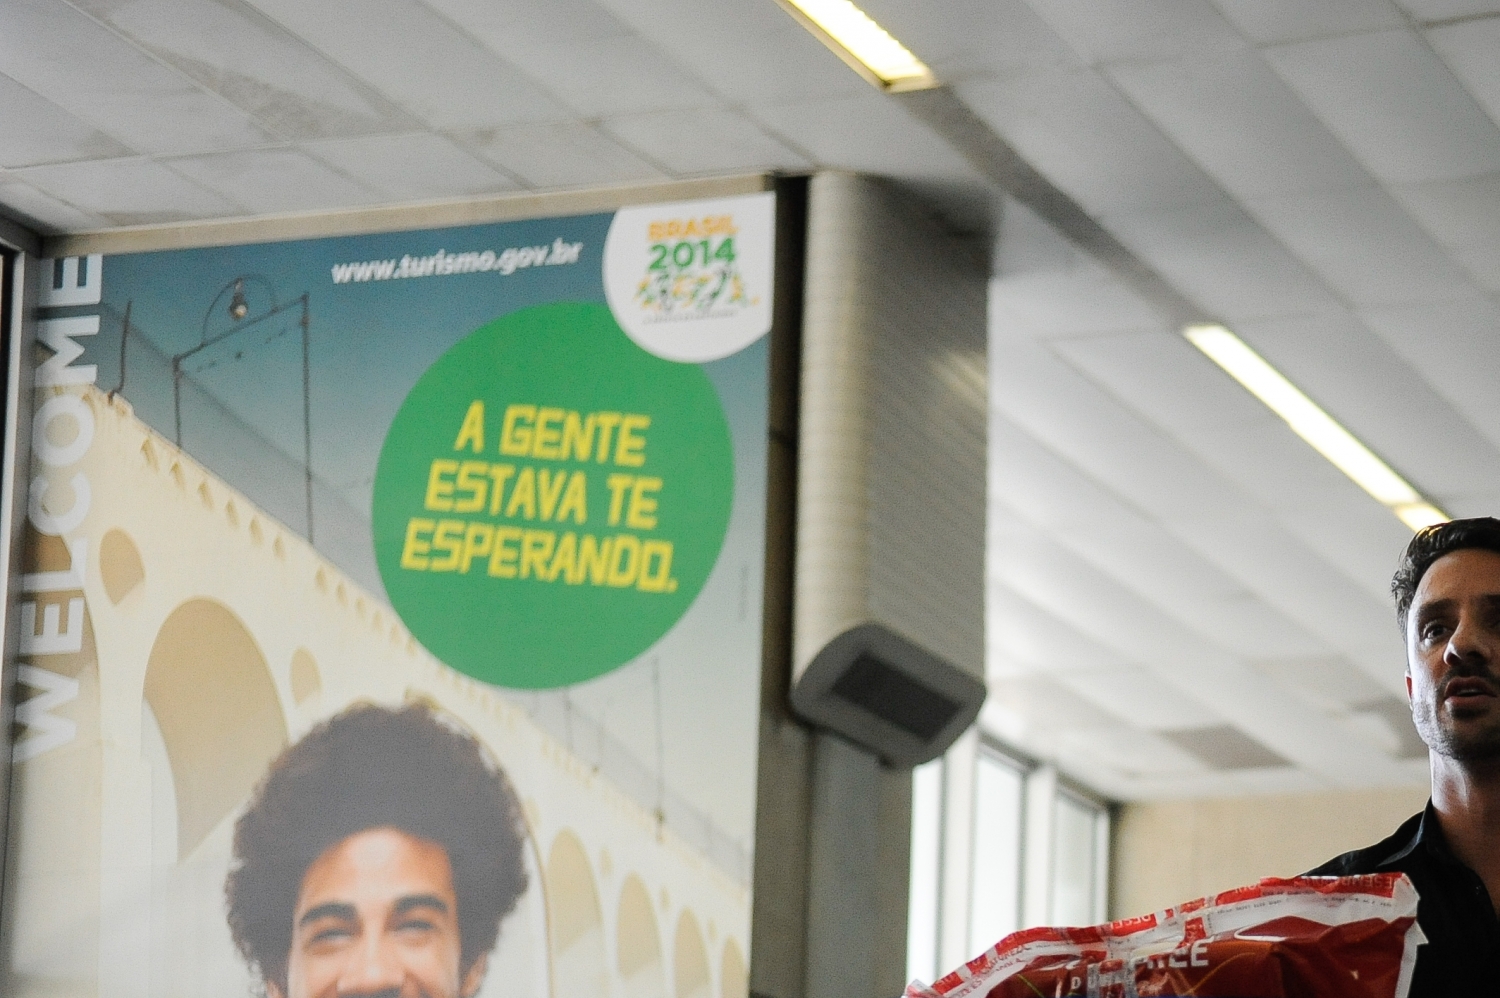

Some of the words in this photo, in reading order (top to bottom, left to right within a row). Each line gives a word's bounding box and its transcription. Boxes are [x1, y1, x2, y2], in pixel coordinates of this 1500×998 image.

[331, 238, 583, 284] www.turismo.gov.br
[648, 216, 738, 240] BRASIL
[649, 238, 736, 270] 2014
[453, 399, 484, 453] A
[498, 404, 651, 468] GENTE
[11, 252, 103, 764] WELCOME
[424, 457, 587, 526] ESTAVA
[606, 472, 664, 530] TE
[401, 517, 678, 593] ESPERANDO.
